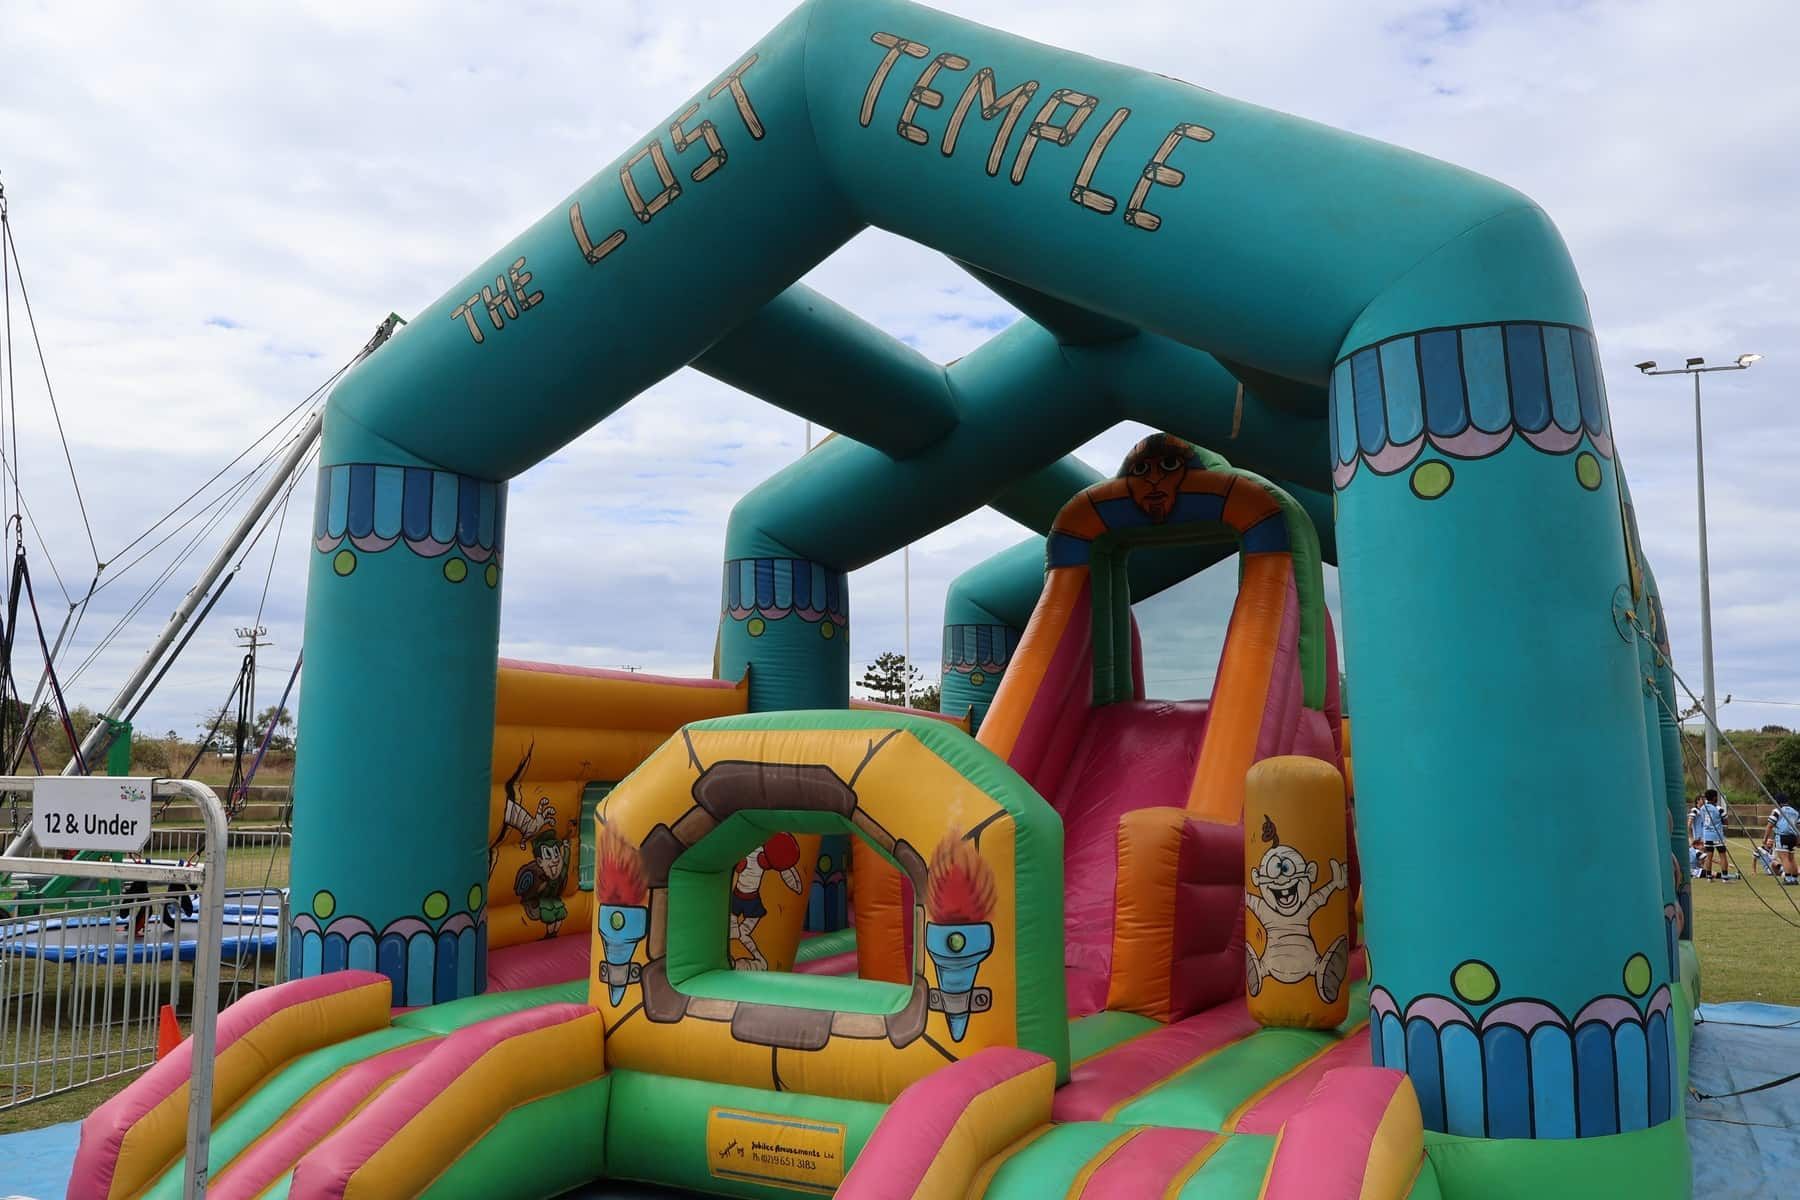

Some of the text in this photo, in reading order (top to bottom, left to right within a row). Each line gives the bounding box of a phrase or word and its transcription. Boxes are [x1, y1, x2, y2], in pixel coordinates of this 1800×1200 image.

[450, 31, 1216, 343] THE LOST TEMPLE
[44, 813, 138, 836] 12 & Under
[775, 1144, 821, 1158] Amusements
